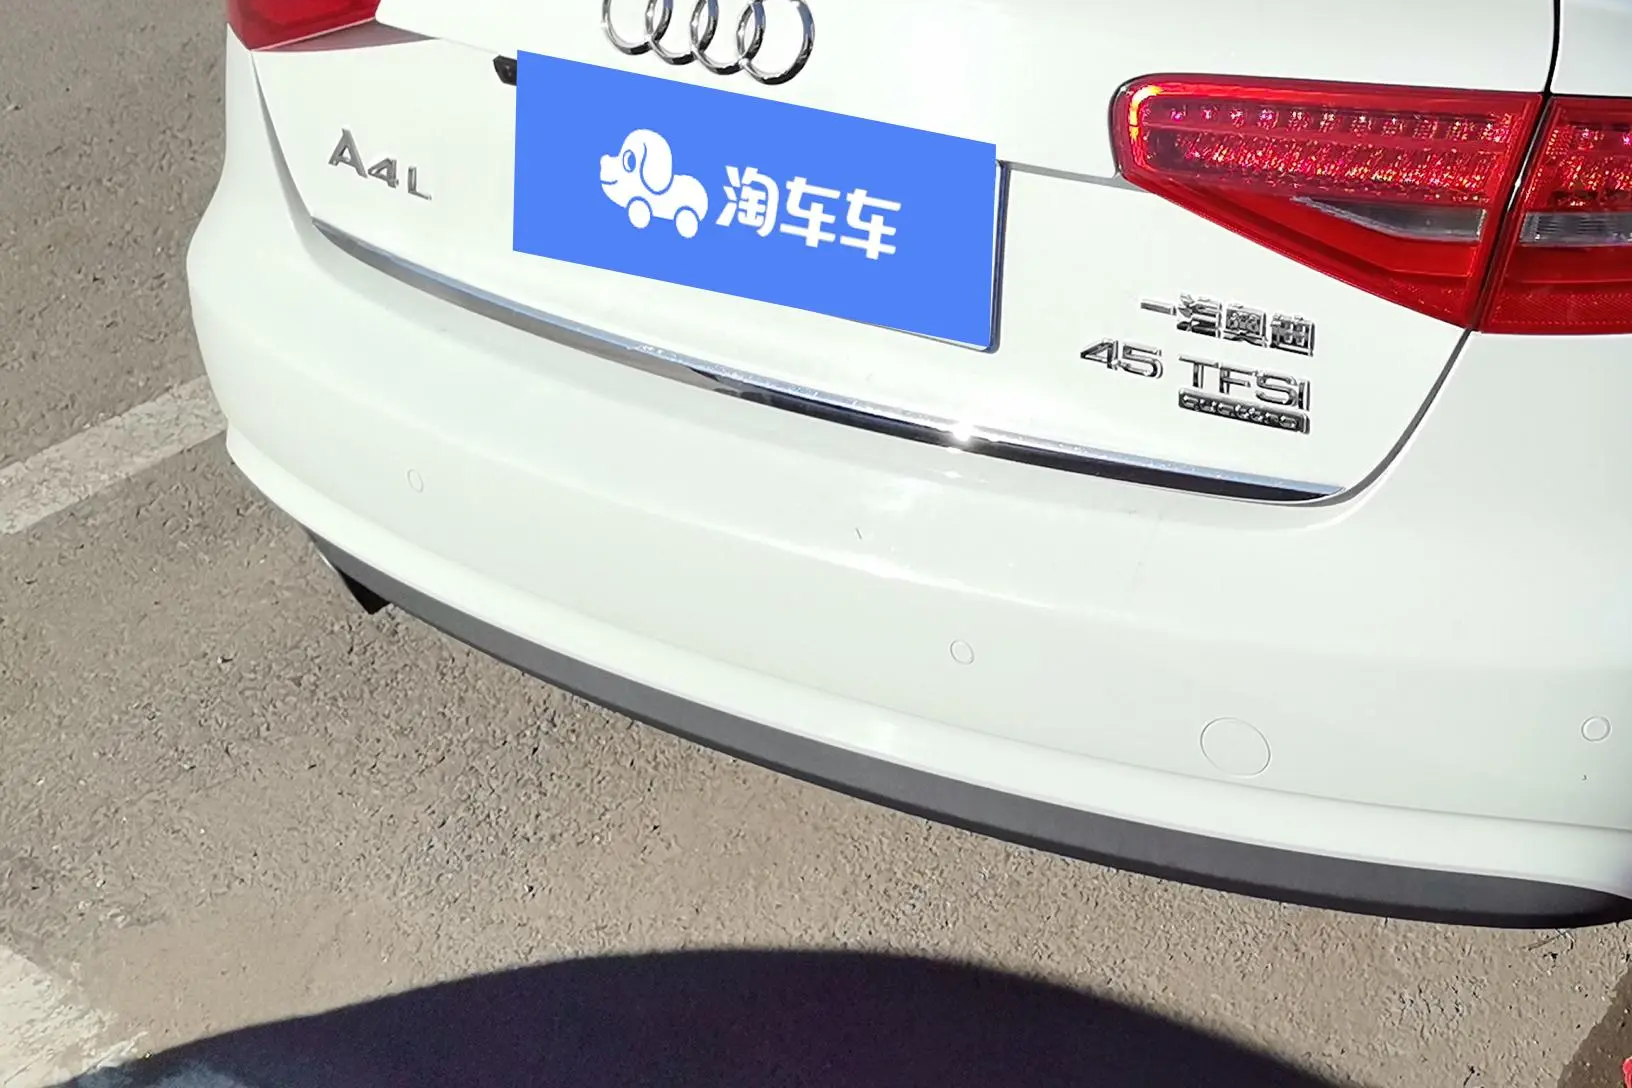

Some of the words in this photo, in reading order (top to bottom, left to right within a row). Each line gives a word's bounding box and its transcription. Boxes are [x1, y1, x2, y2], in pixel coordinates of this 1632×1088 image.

[1139, 292, 1315, 357] 一汽奥迪
[1080, 338, 1164, 380] 45
[1178, 354, 1311, 411] TFSI
